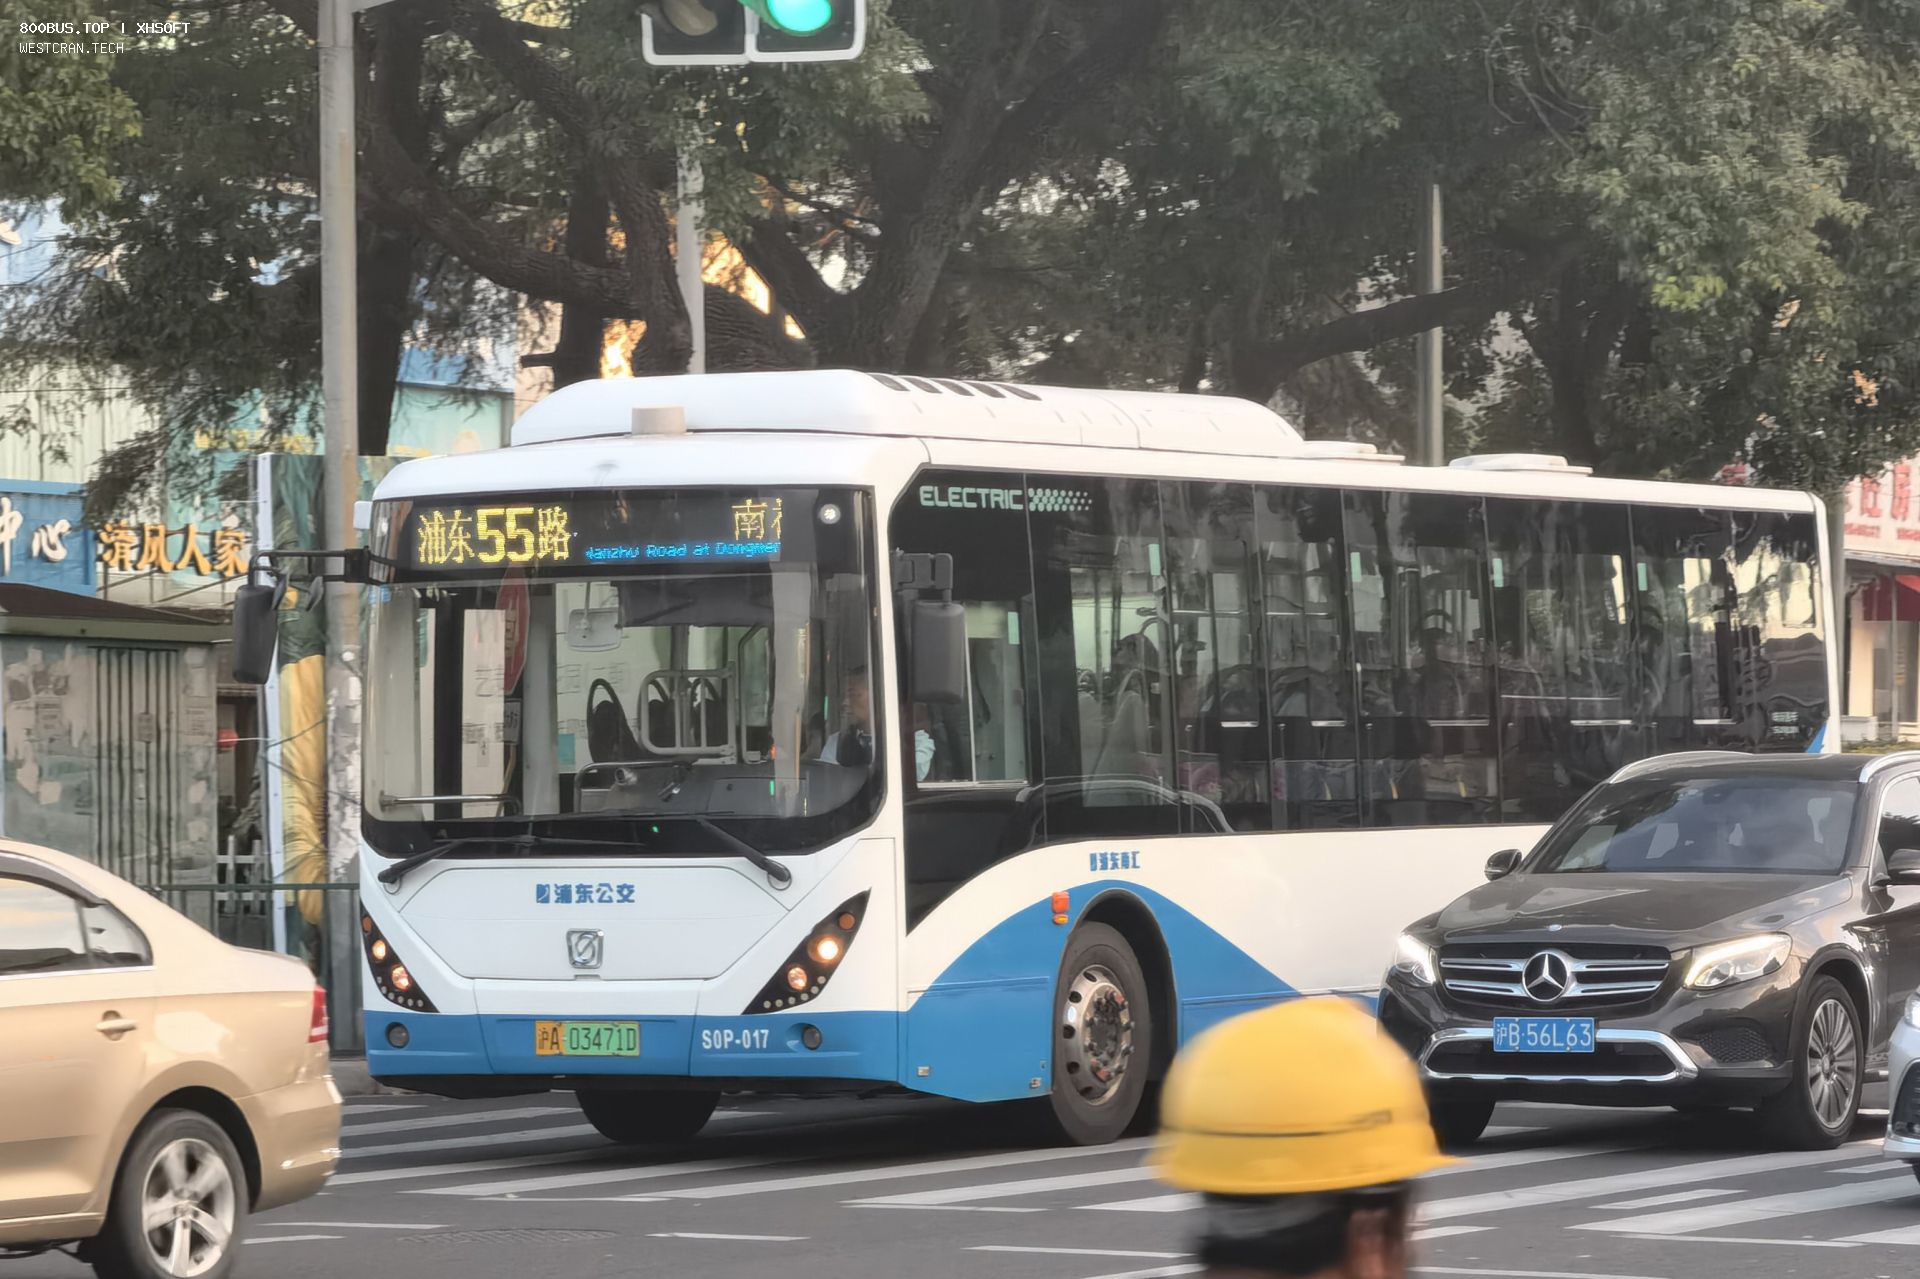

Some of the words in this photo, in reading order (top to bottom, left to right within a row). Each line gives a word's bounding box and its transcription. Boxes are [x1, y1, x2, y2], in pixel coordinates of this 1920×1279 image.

[919, 485, 1023, 510] ELECTRIC
[100, 518, 249, 577] 清风人家
[418, 506, 571, 564] 浦东55路
[646, 543, 688, 557] Road
[693, 543, 710, 556] at
[553, 883, 636, 904] 浦东公交
